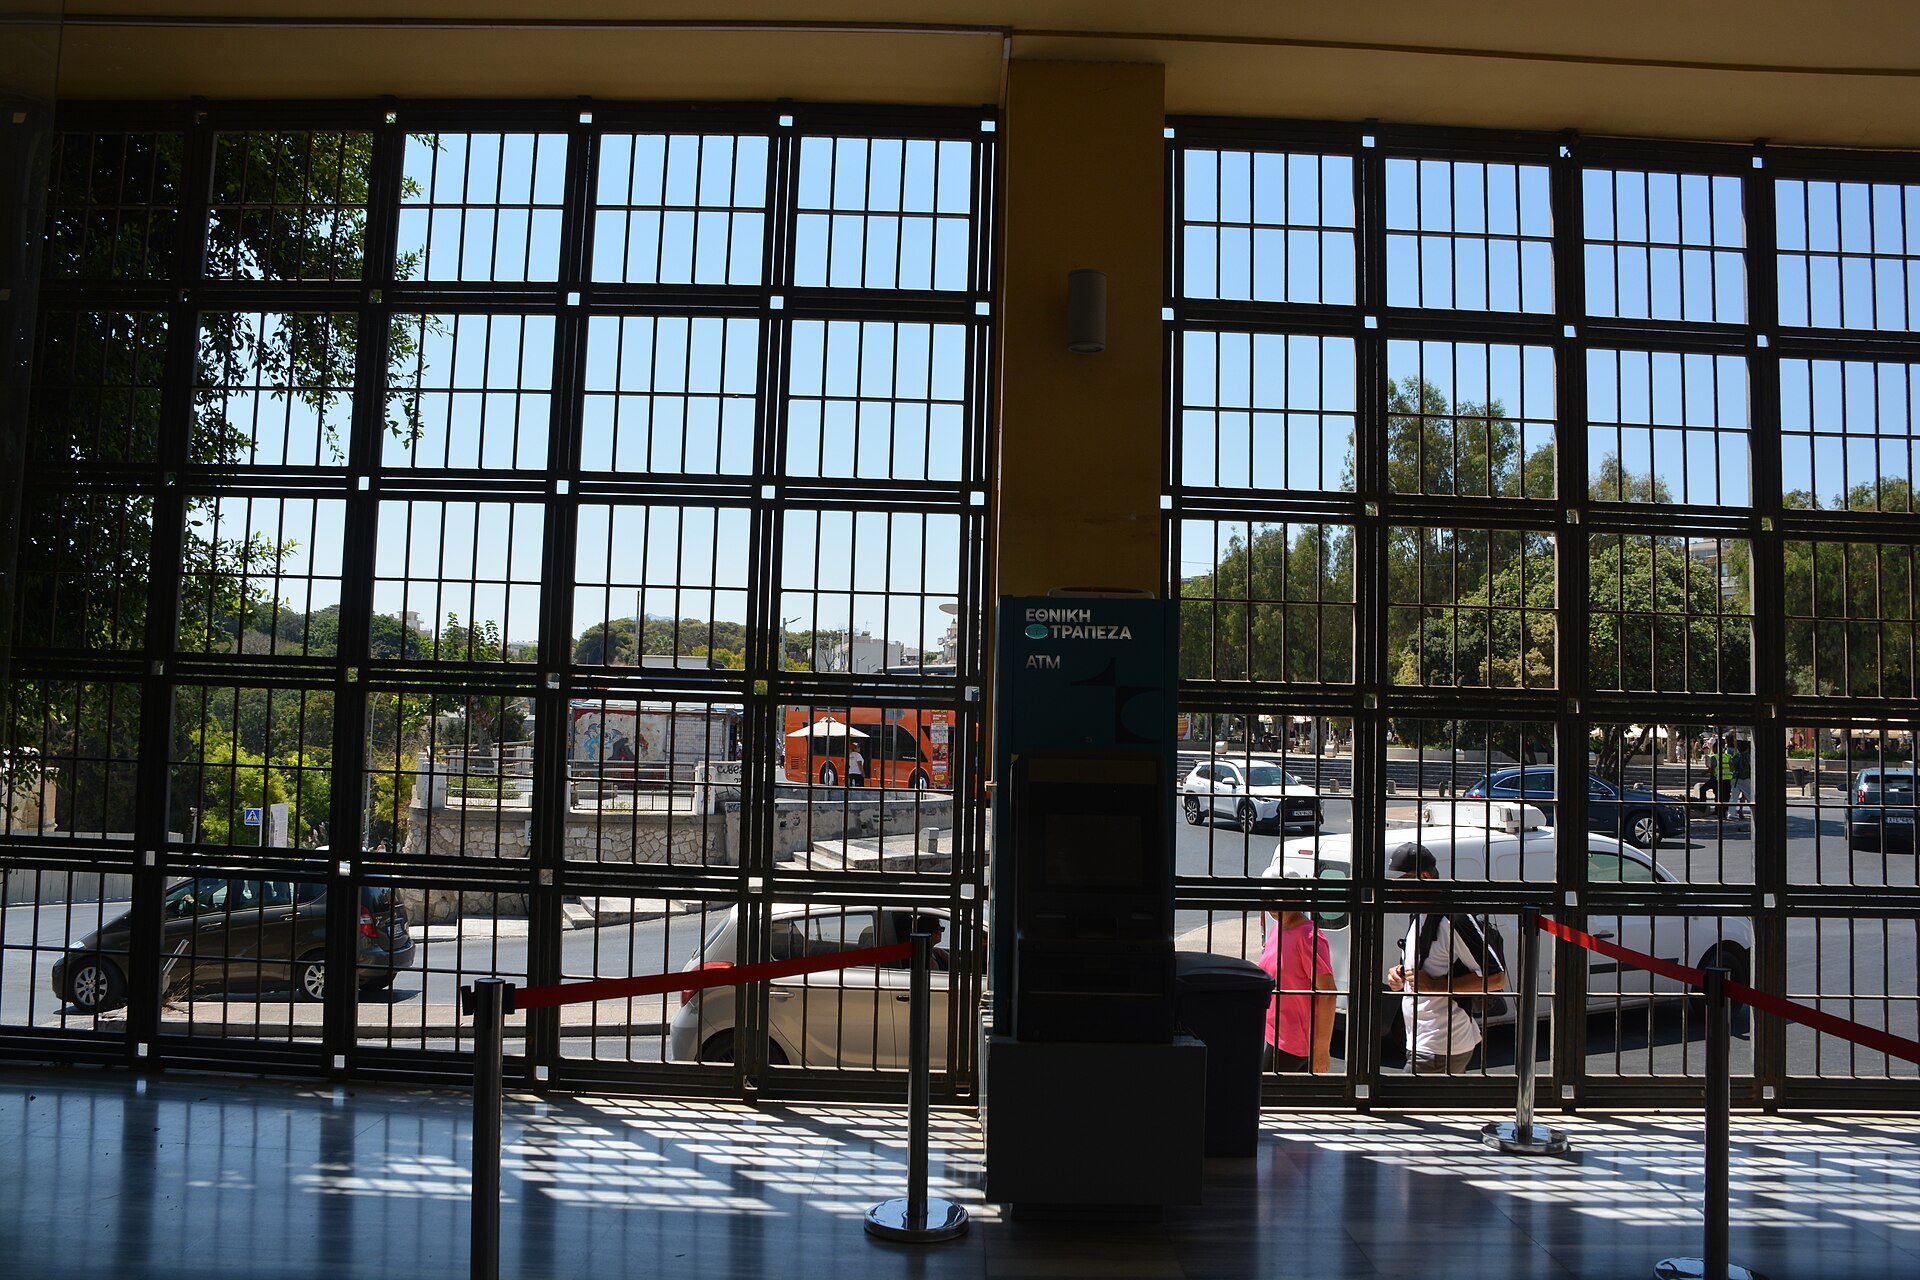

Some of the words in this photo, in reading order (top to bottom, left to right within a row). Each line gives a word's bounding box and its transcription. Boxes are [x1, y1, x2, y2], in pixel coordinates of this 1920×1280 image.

[1026, 609, 1091, 623] ΕΘΝΙΚΗ
[1050, 625, 1132, 640] ΤΡΑΠΕΖΑ
[1026, 655, 1061, 669] ATM
